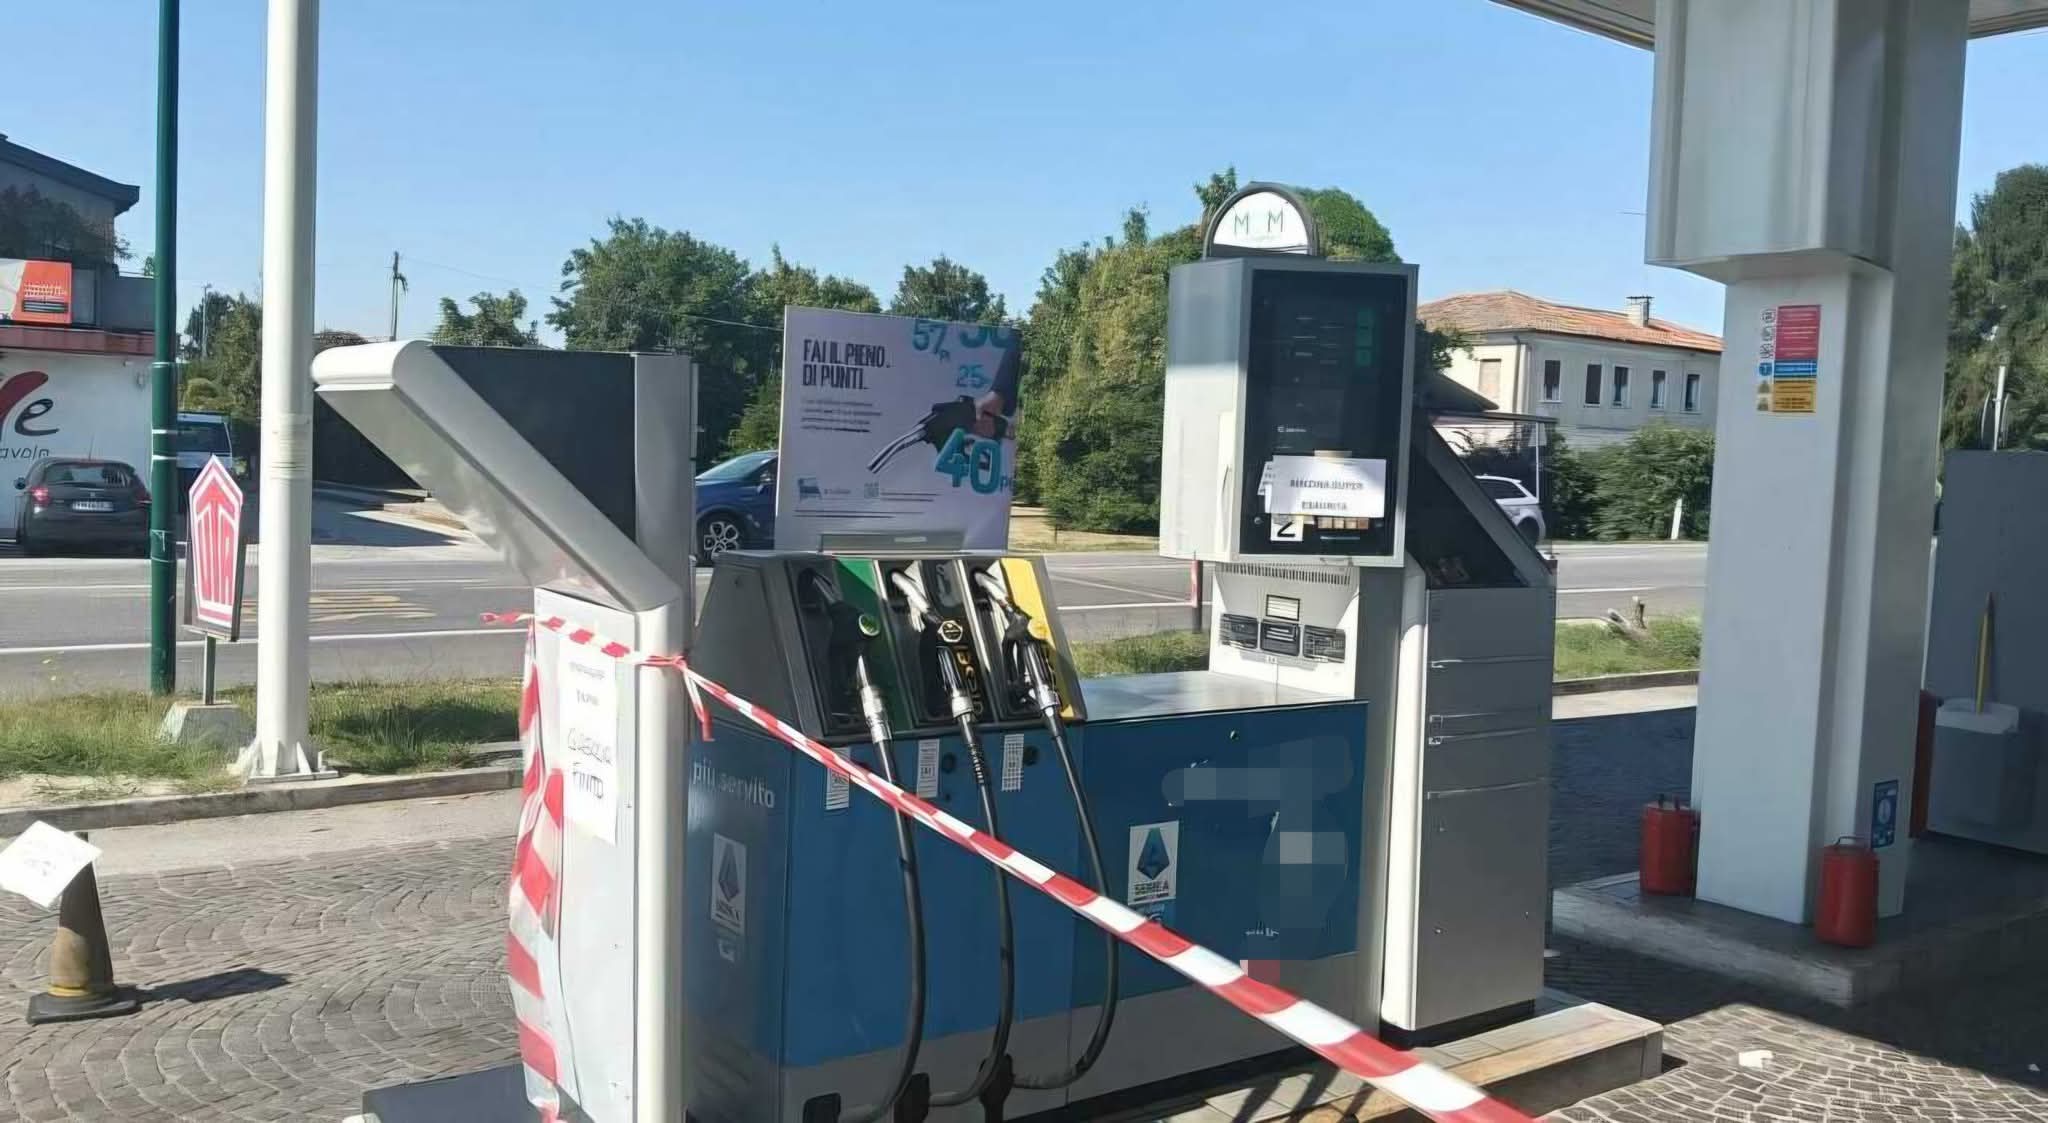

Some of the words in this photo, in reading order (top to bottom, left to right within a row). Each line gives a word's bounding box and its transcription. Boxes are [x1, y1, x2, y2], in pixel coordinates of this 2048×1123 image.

[803, 339, 826, 363] FAI
[830, 341, 844, 364] IL
[845, 343, 891, 369] PIENO.
[802, 364, 817, 386] DI
[820, 365, 870, 390] PUNTI.
[935, 427, 1001, 495] 40
